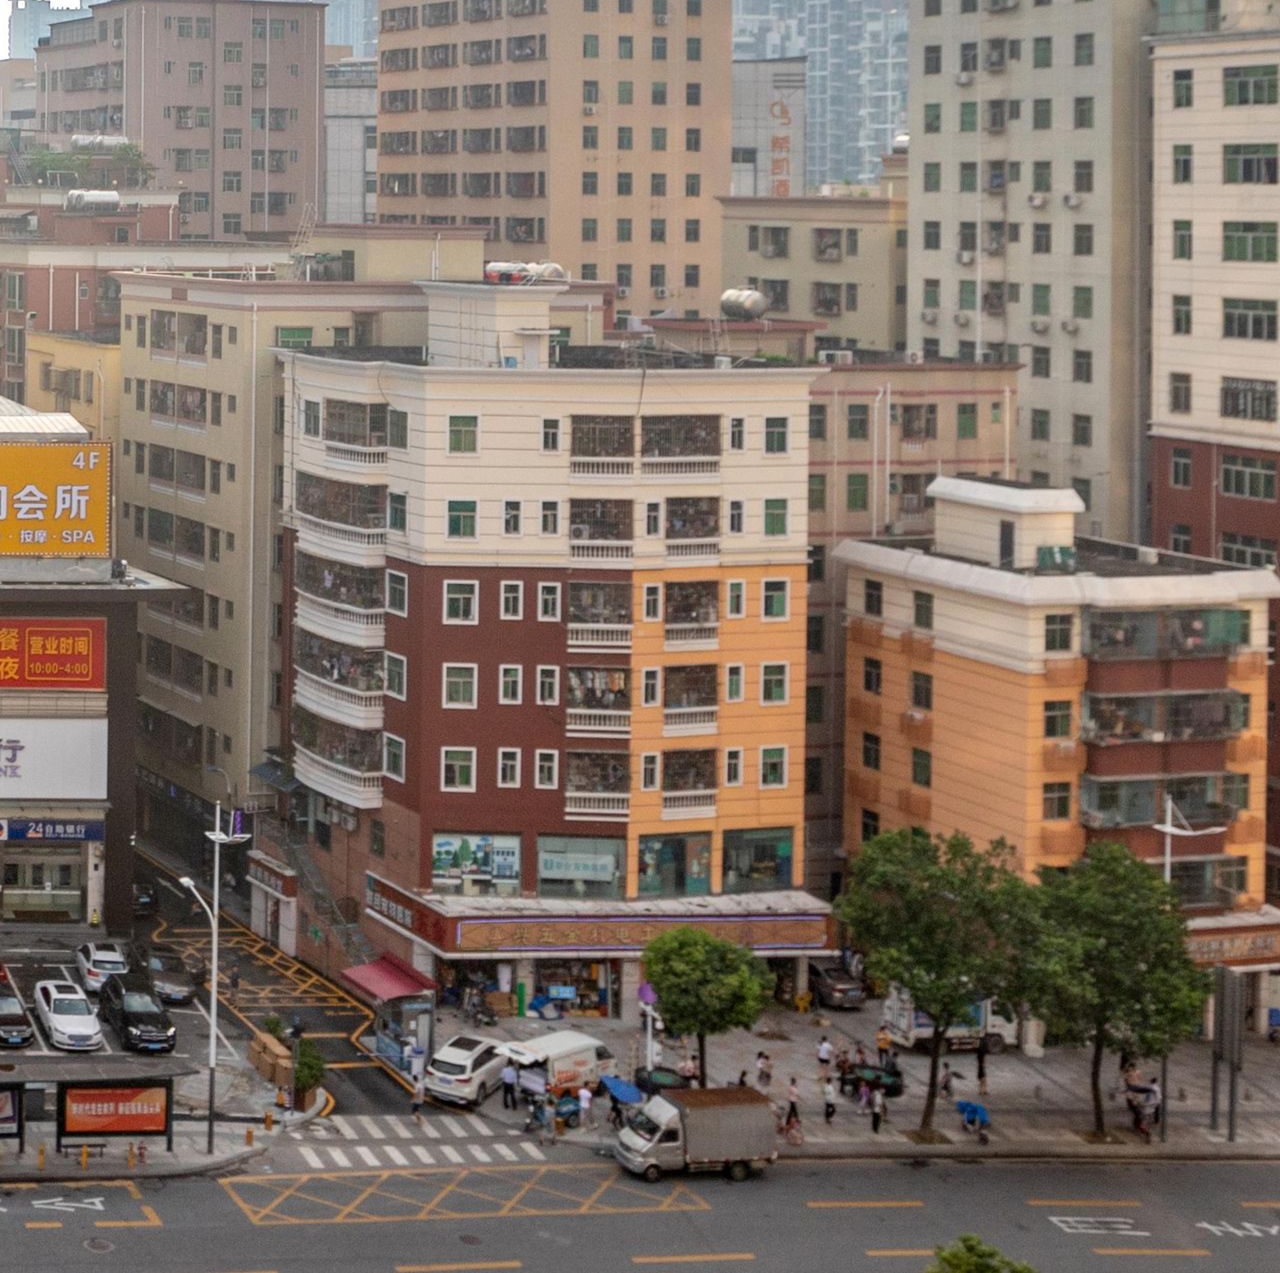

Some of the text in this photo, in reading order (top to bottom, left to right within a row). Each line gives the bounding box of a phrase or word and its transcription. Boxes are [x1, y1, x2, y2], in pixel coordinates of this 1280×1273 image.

[72, 451, 100, 469] 4F
[30, 637, 88, 655] 营业时间
[30, 663, 88, 674] 10:00-4:00
